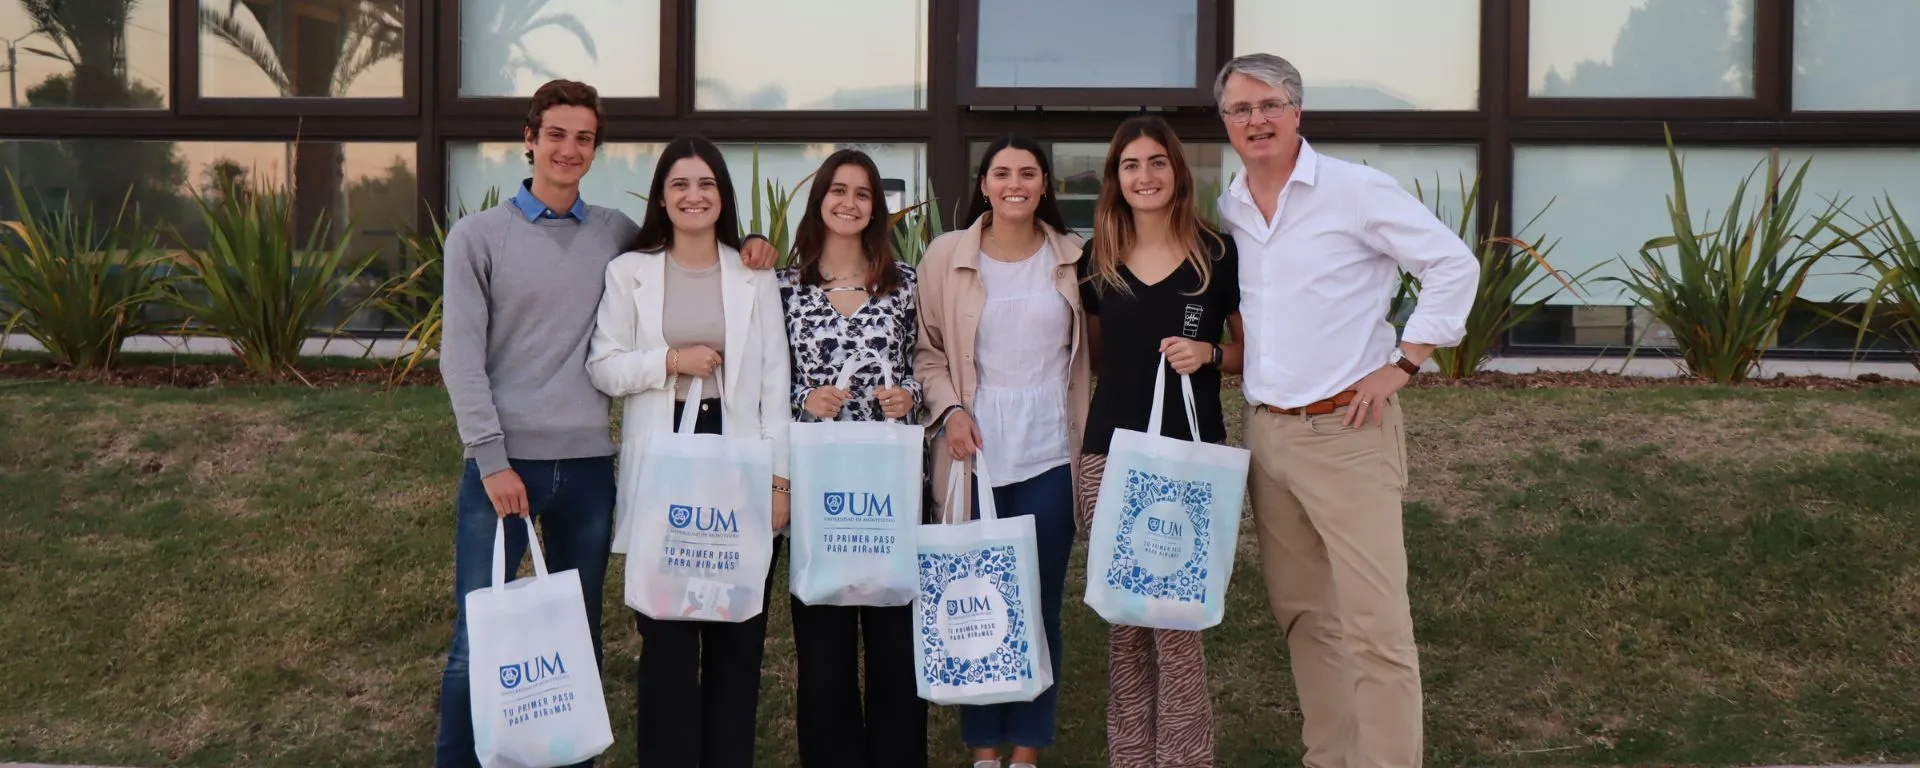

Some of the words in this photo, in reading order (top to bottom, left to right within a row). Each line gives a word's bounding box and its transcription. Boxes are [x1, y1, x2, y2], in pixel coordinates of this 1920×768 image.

[848, 492, 894, 516] UM
[695, 507, 739, 532] UM
[1161, 520, 1182, 536] UM
[824, 534, 833, 543] TU
[837, 534, 869, 543] PRIMER
[874, 536, 895, 544] PASO
[665, 547, 675, 556] TU
[680, 548, 714, 559] PRIMER
[718, 551, 740, 560] PASO
[827, 544, 848, 553] PARA
[668, 557, 691, 567] PARA
[960, 595, 992, 614] UM
[523, 651, 566, 682] UM
[503, 708, 514, 718] TU
[518, 697, 549, 714] PRIMER
[552, 691, 574, 704] PASO
[509, 713, 529, 727] PARA
